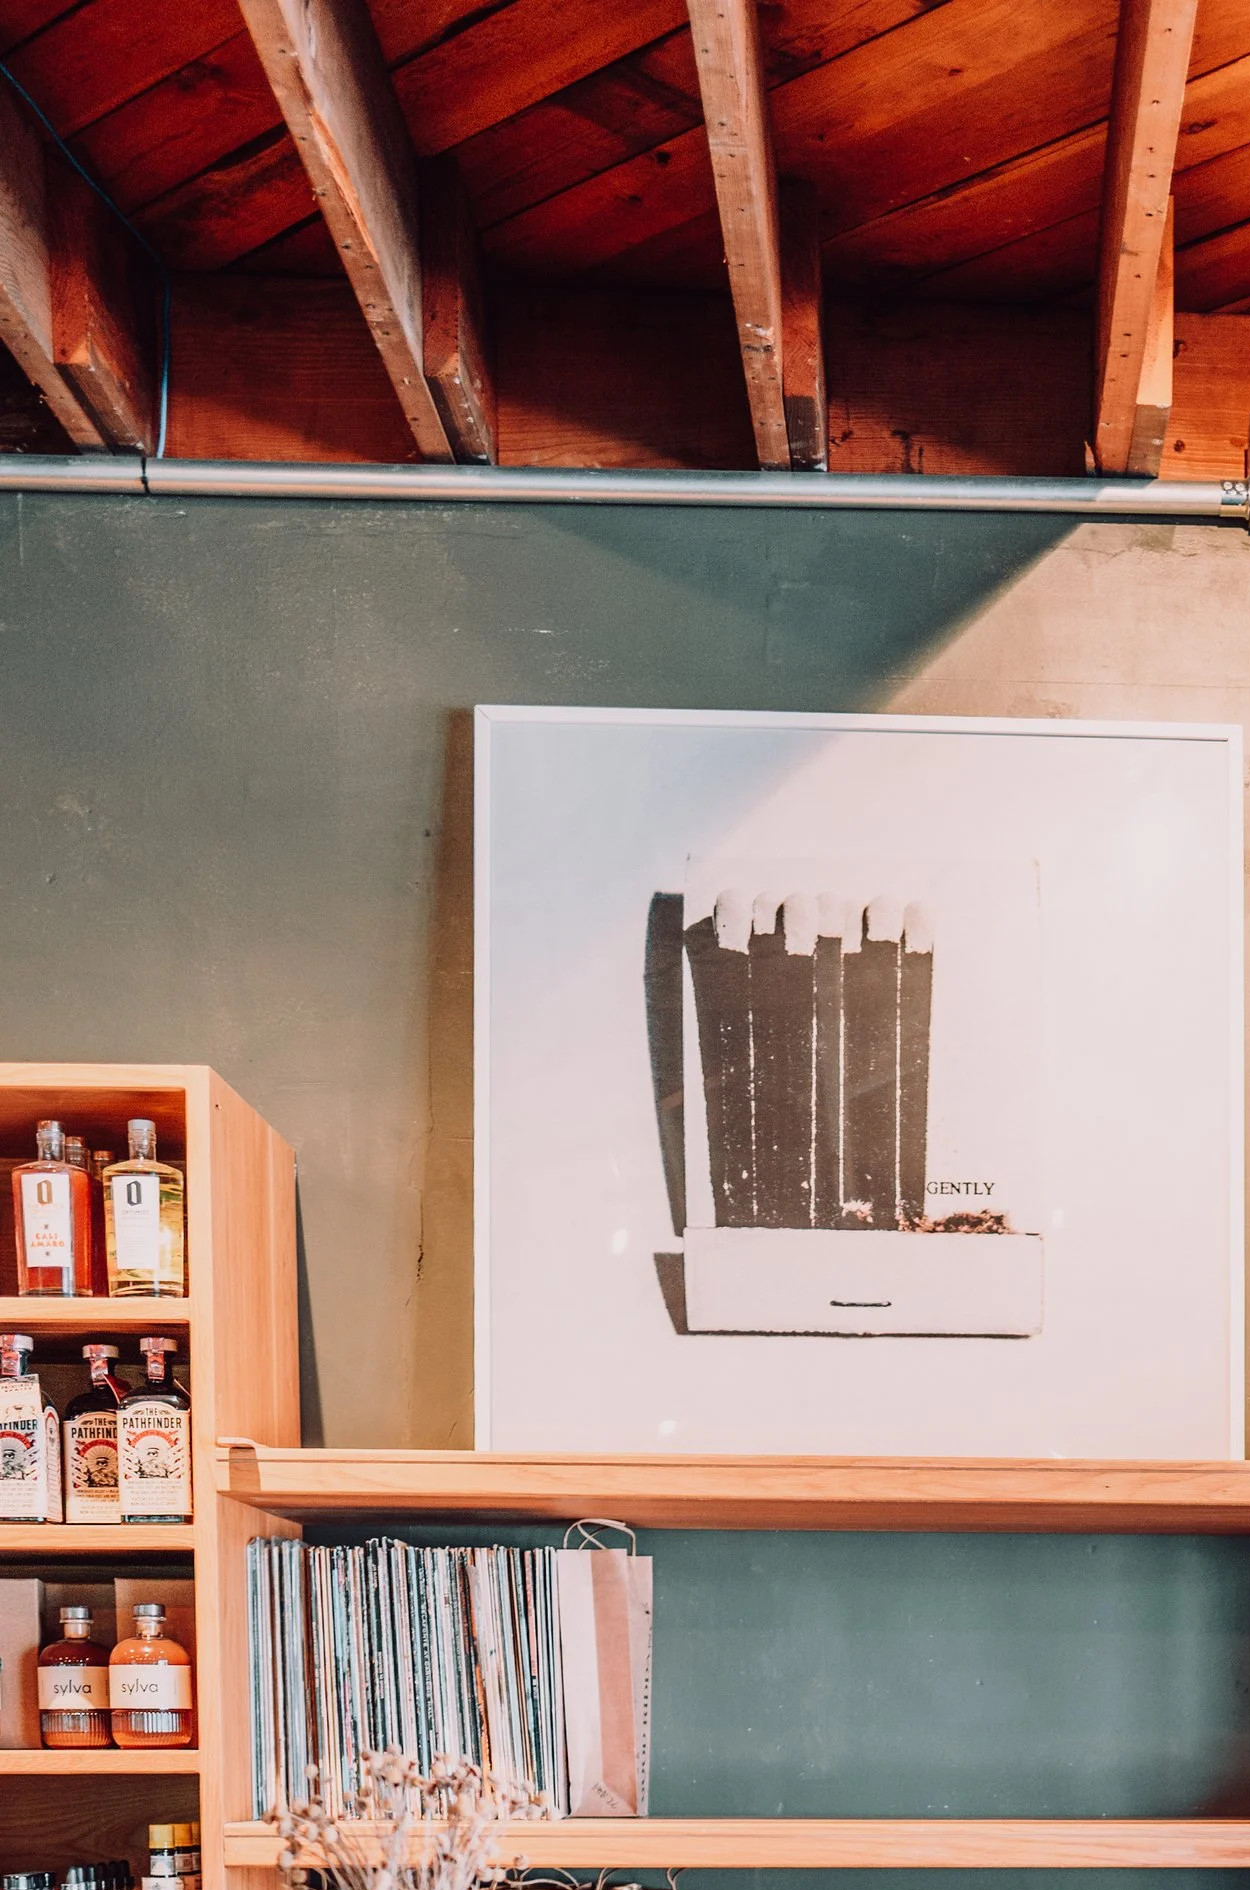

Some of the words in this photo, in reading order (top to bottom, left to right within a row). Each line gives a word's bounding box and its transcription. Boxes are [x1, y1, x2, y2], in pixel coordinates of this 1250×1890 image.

[926, 1181, 996, 1196] GENTLY
[35, 1232, 59, 1240] CALI
[30, 1240, 65, 1248] AMARO
[145, 1407, 158, 1416] THE
[94, 1417, 107, 1426] THE
[122, 1417, 182, 1429] PATHFINDER
[71, 1427, 118, 1439] PATHFIND
[54, 1680, 92, 1696] sylva
[121, 1678, 158, 1695] sylva
